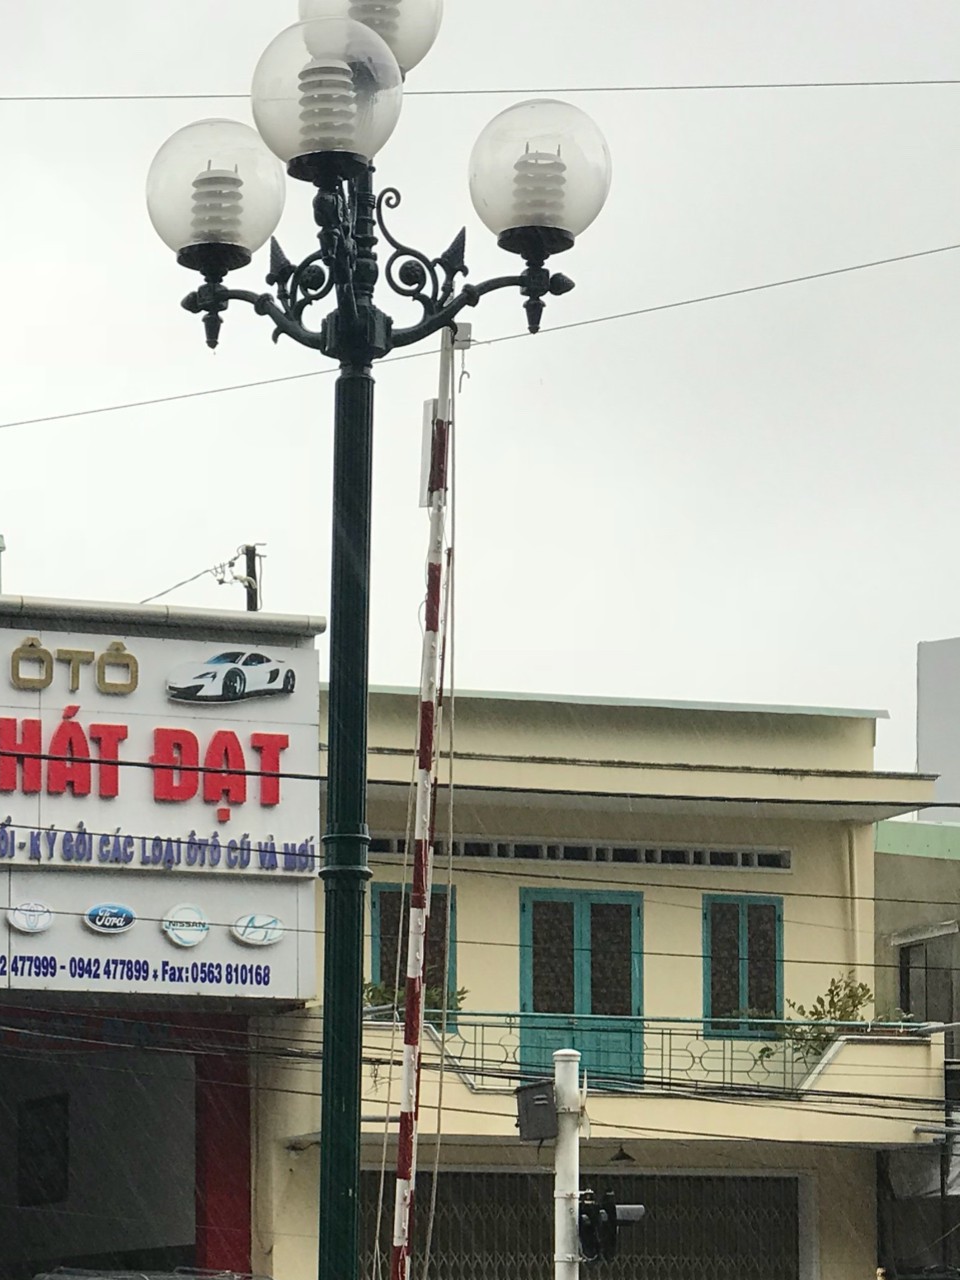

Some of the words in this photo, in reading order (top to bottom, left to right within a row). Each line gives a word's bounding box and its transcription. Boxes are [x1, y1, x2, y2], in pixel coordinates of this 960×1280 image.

[149, 728, 289, 822] ĐẠT
[98, 827, 135, 864] CÁC
[140, 836, 181, 871] LOẠI
[257, 834, 278, 871] VÀ
[95, 906, 126, 926] Ford
[168, 920, 207, 929] NISSAN
[11, 955, 57, 978] 477999
[69, 956, 101, 979] 0942
[103, 958, 150, 982] 477899
[225, 963, 271, 986] 810168
